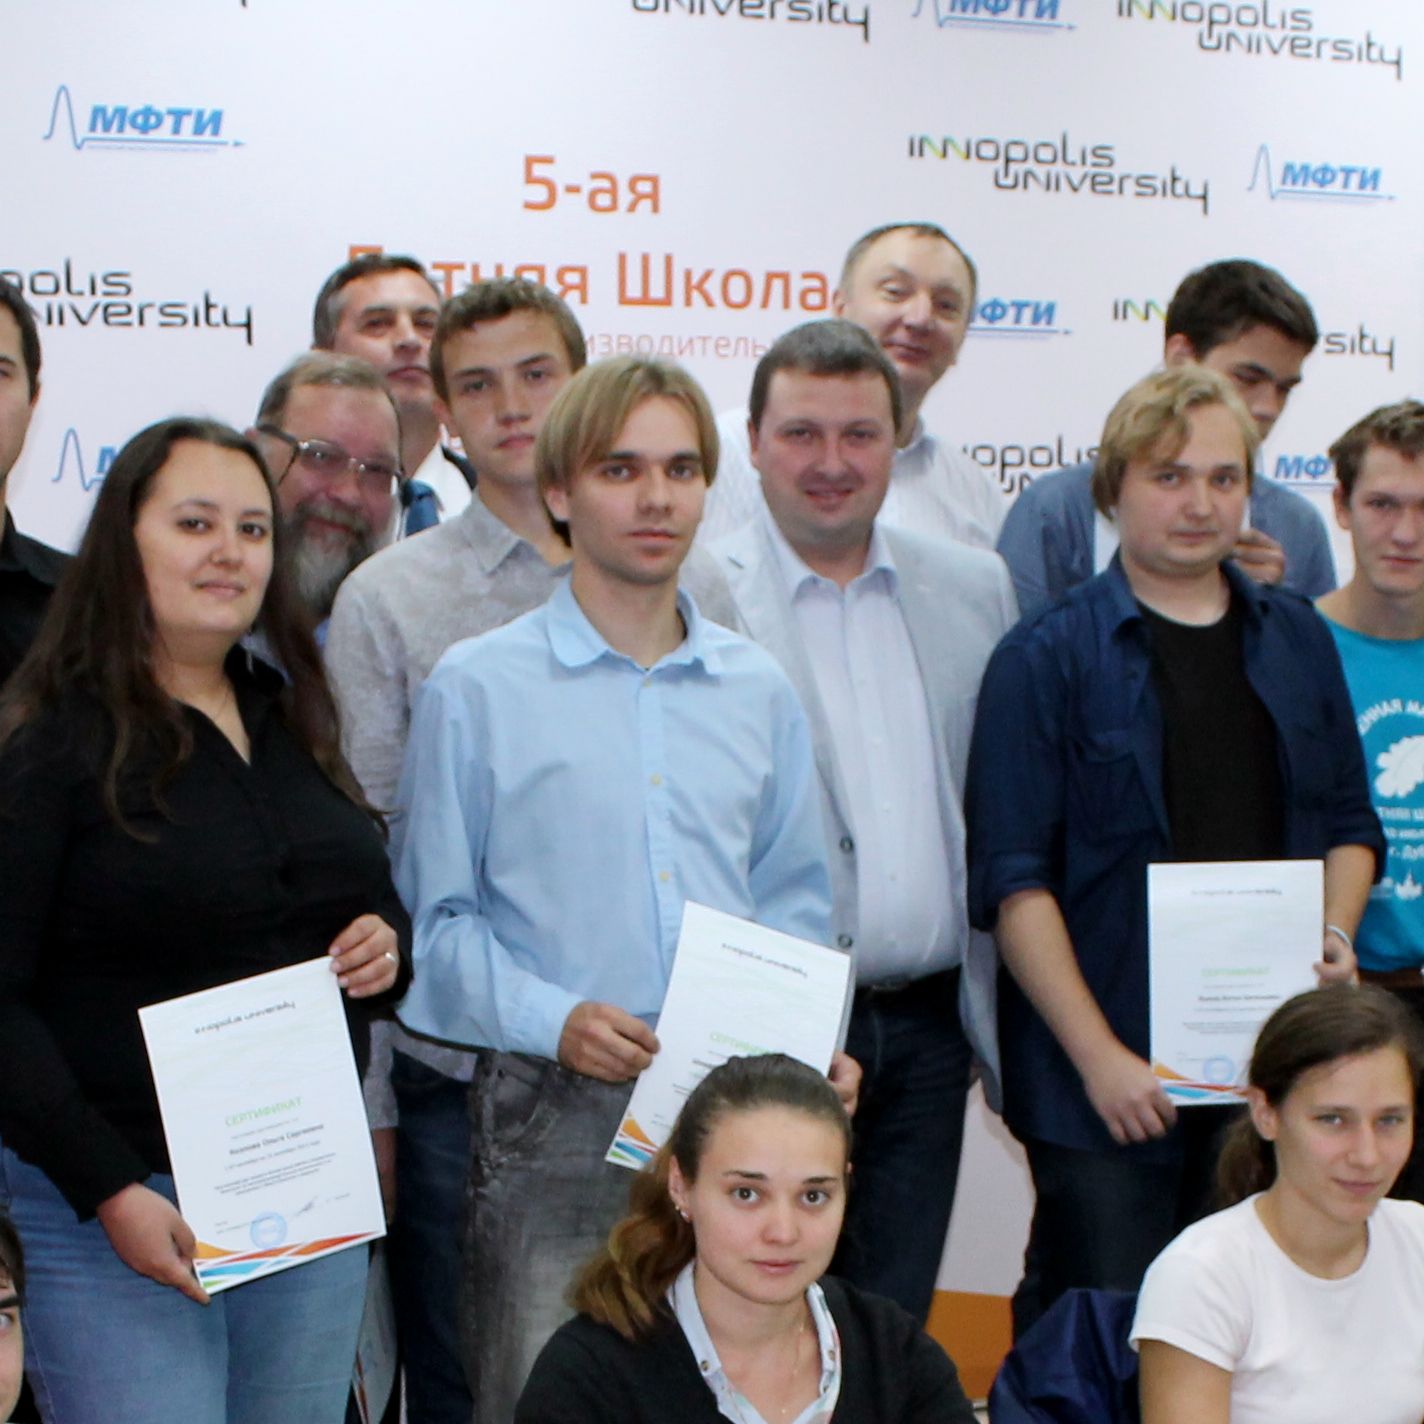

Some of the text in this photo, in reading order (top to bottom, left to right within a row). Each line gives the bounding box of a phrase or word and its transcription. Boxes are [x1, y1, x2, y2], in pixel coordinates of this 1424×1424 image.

[88, 103, 225, 137] МФТИ
[522, 154, 662, 214] 5-ая
[1281, 161, 1381, 192] МФТИ
[617, 252, 829, 311] Школа
[974, 297, 1057, 326] ФТИ
[1274, 454, 1333, 480] МФ
